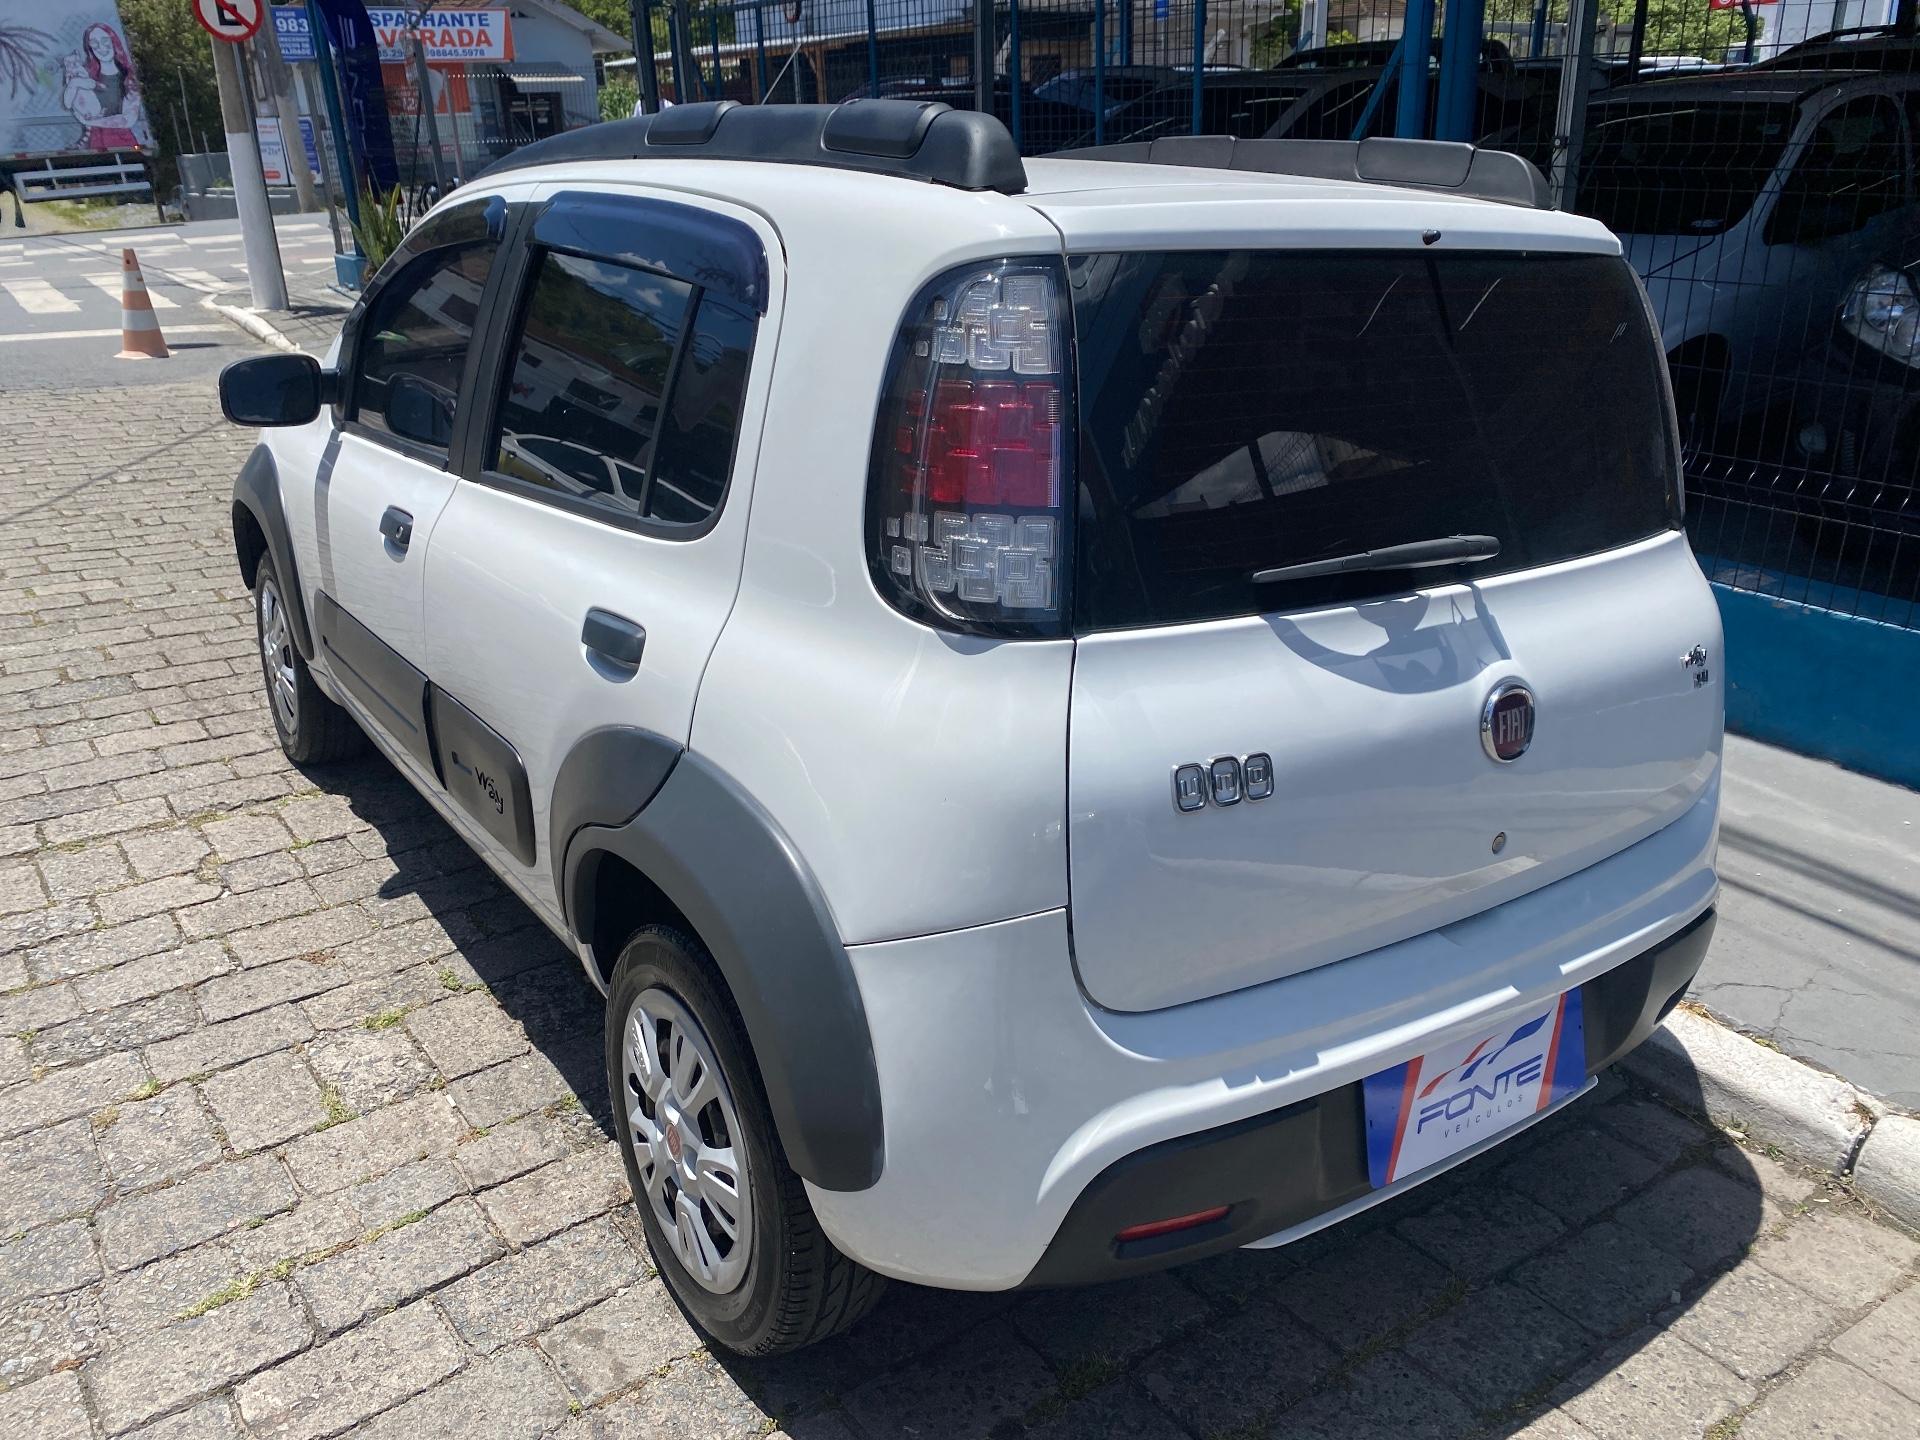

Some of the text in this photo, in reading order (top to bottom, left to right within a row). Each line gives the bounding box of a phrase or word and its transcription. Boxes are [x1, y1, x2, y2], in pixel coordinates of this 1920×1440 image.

[369, 12, 490, 28] SPACHANTE
[376, 28, 494, 49] VRADA
[1498, 704, 1529, 746] FIAT
[474, 766, 504, 815] Way
[1416, 1052, 1544, 1135] FONTE
